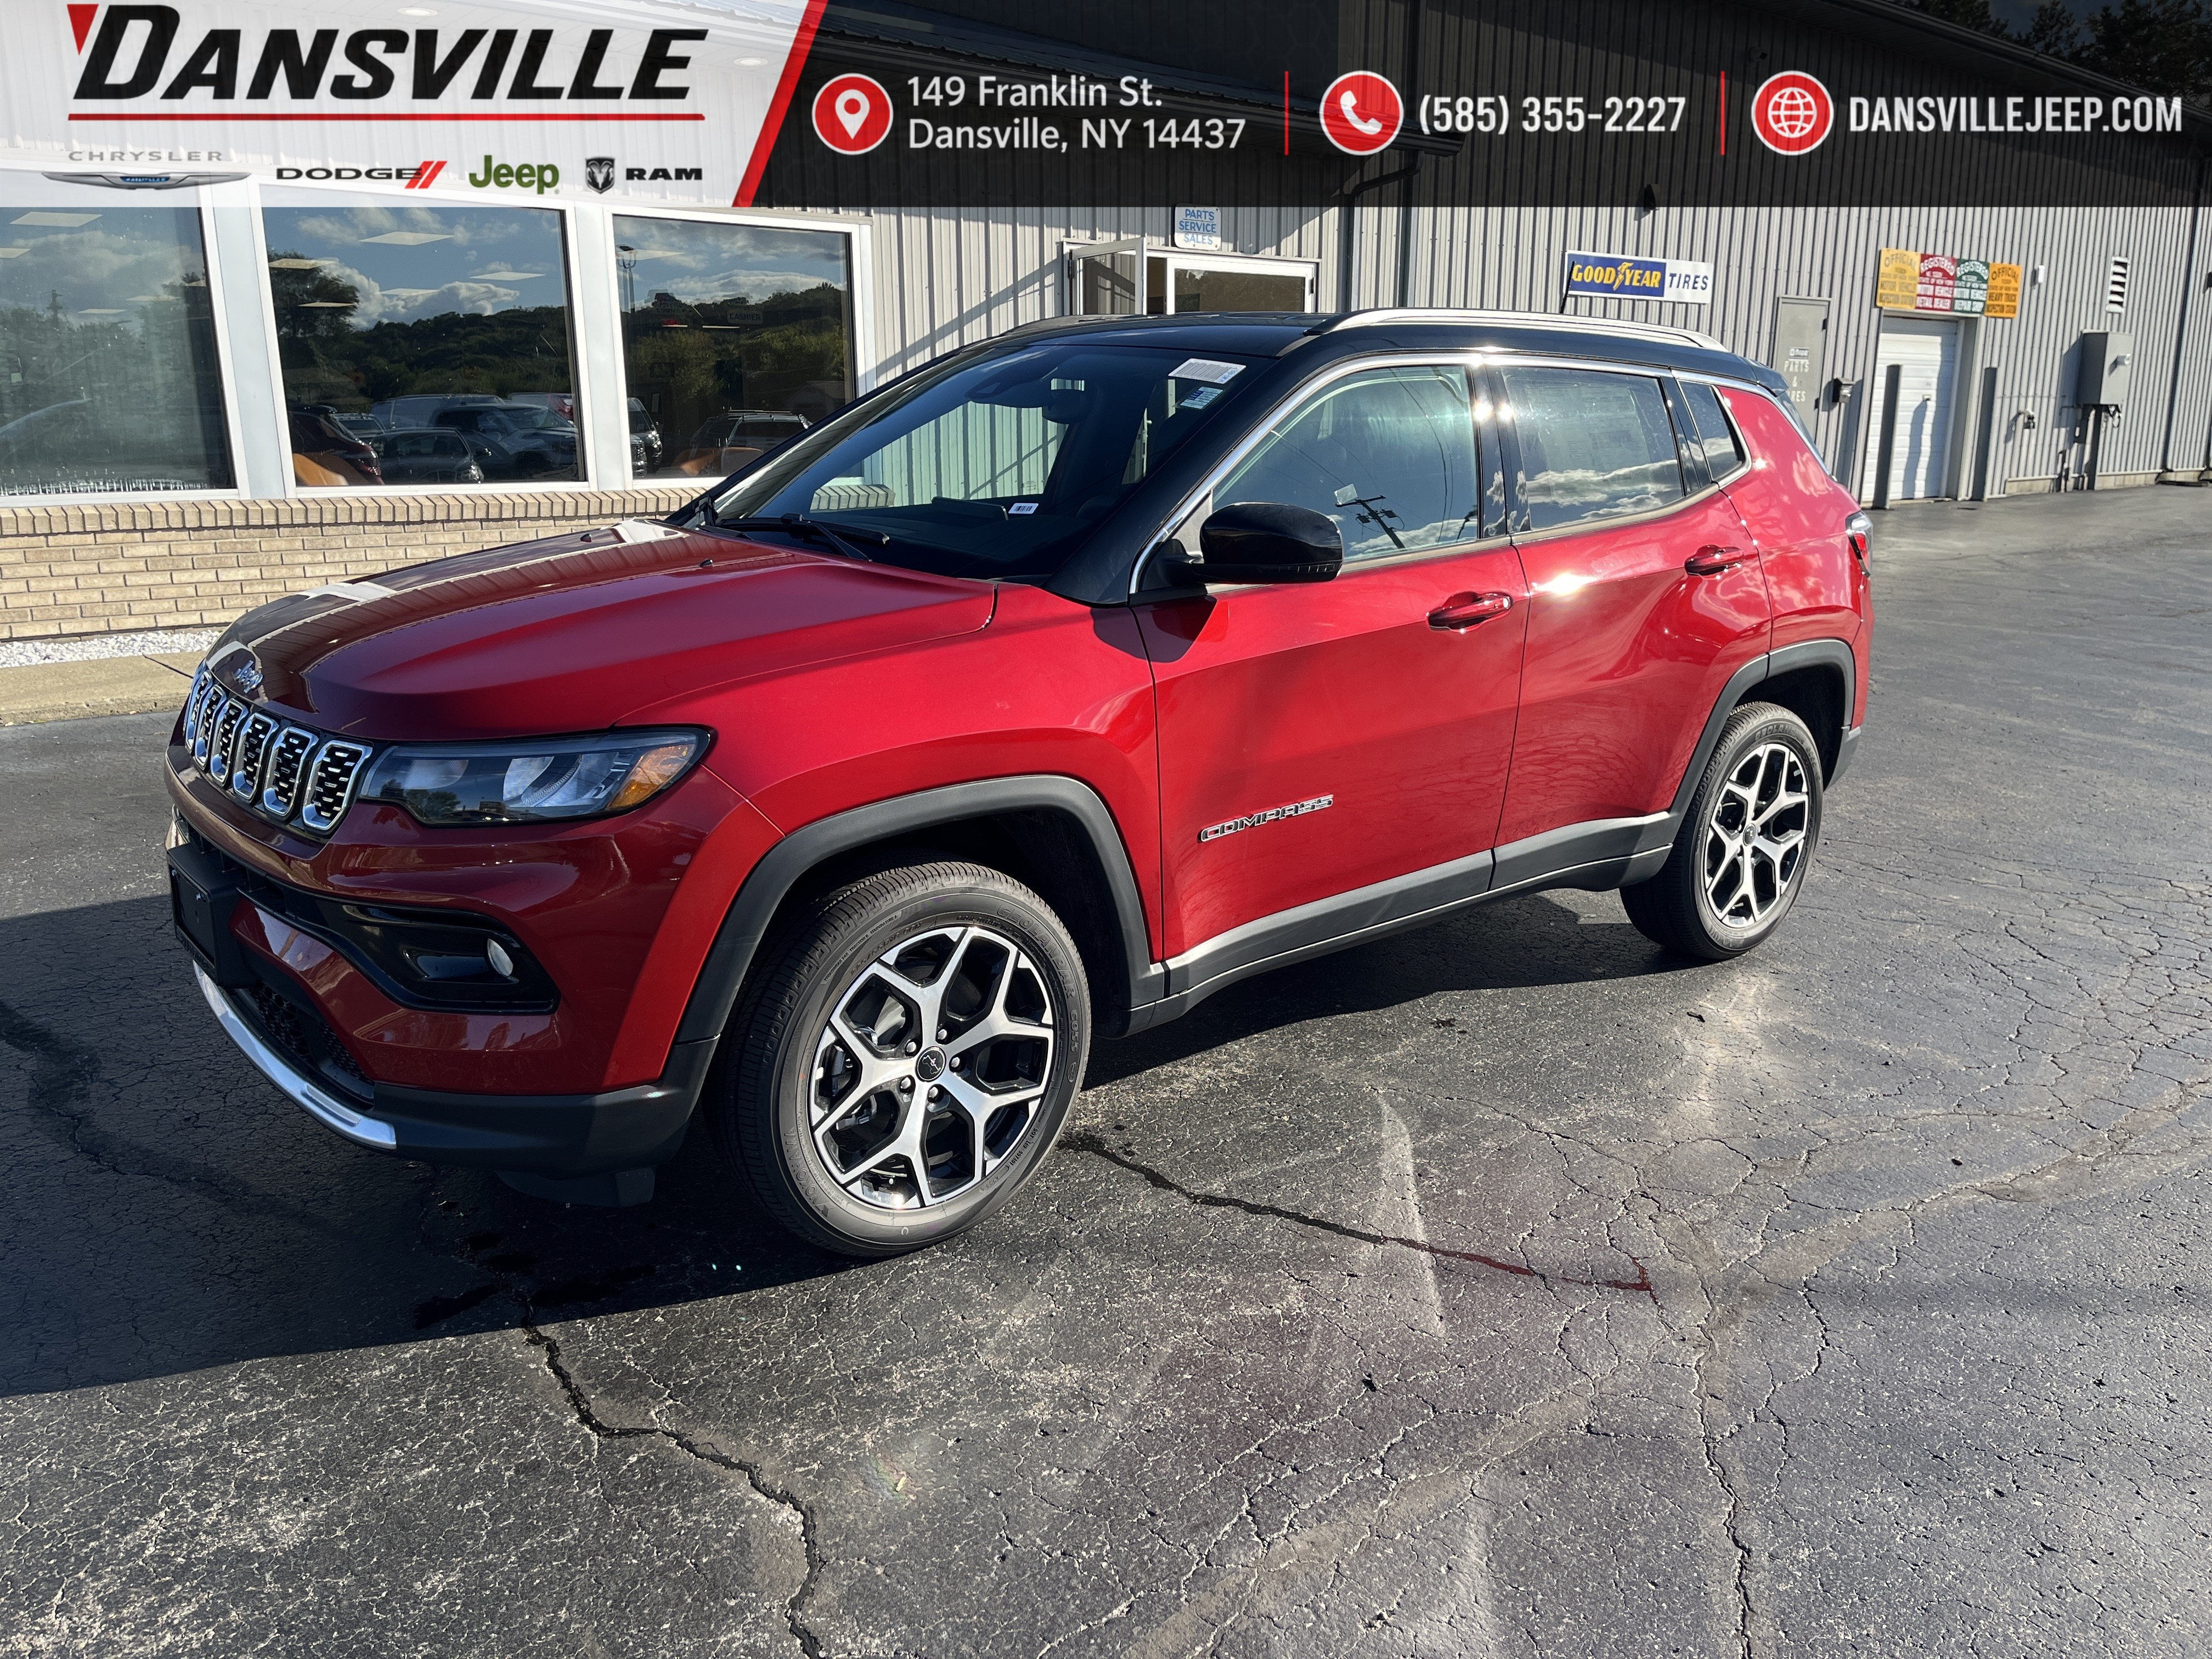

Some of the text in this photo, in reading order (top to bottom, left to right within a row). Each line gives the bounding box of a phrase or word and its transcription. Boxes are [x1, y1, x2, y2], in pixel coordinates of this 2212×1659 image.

[1185, 208, 1215, 221] PARTS
[1179, 221, 1217, 233] SERVICE
[1184, 234, 1213, 245] SALES
[1572, 263, 1709, 290] GOODYEAR TIRES
[1784, 360, 1809, 373] PARTS
[1200, 794, 1334, 842] COMPASS
[996, 905, 1076, 1000] GEOLANDAR
[784, 1125, 821, 1205] YOKOHAMA
